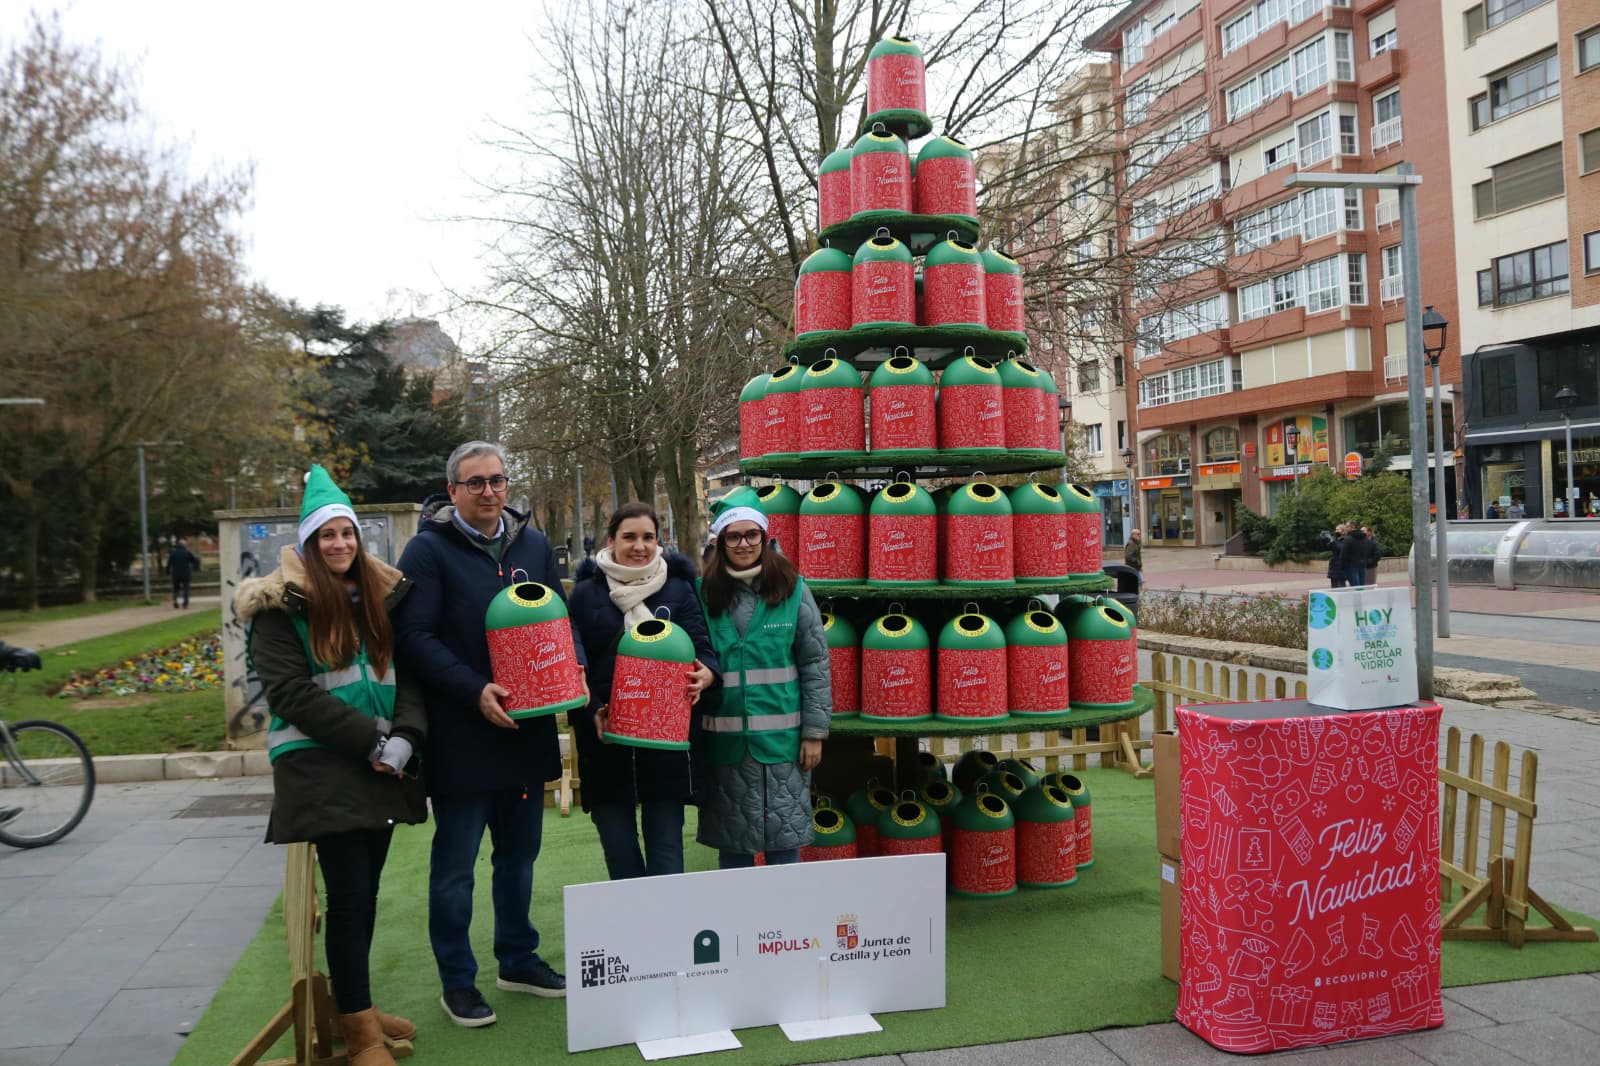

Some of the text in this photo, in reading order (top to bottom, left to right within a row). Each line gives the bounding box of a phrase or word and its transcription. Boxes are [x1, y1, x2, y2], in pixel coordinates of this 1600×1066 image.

[1355, 608, 1393, 627] HOY
[1364, 640, 1390, 650] PARA
[1354, 647, 1402, 662] RECICLAR
[527, 651, 567, 675] Navidad
[1361, 658, 1394, 670] VIDRIO
[1319, 818, 1387, 871] Feliz
[1287, 851, 1416, 926] Navidad
[758, 930, 782, 940] NOS
[861, 935, 911, 948] Junta de
[607, 956, 621, 966] PA
[830, 947, 911, 962] Castilla y León
[607, 965, 630, 975] LEN
[1326, 969, 1388, 985] ECOVIDRIO
[607, 971, 677, 985] CIA AYUNTAMIENTO
